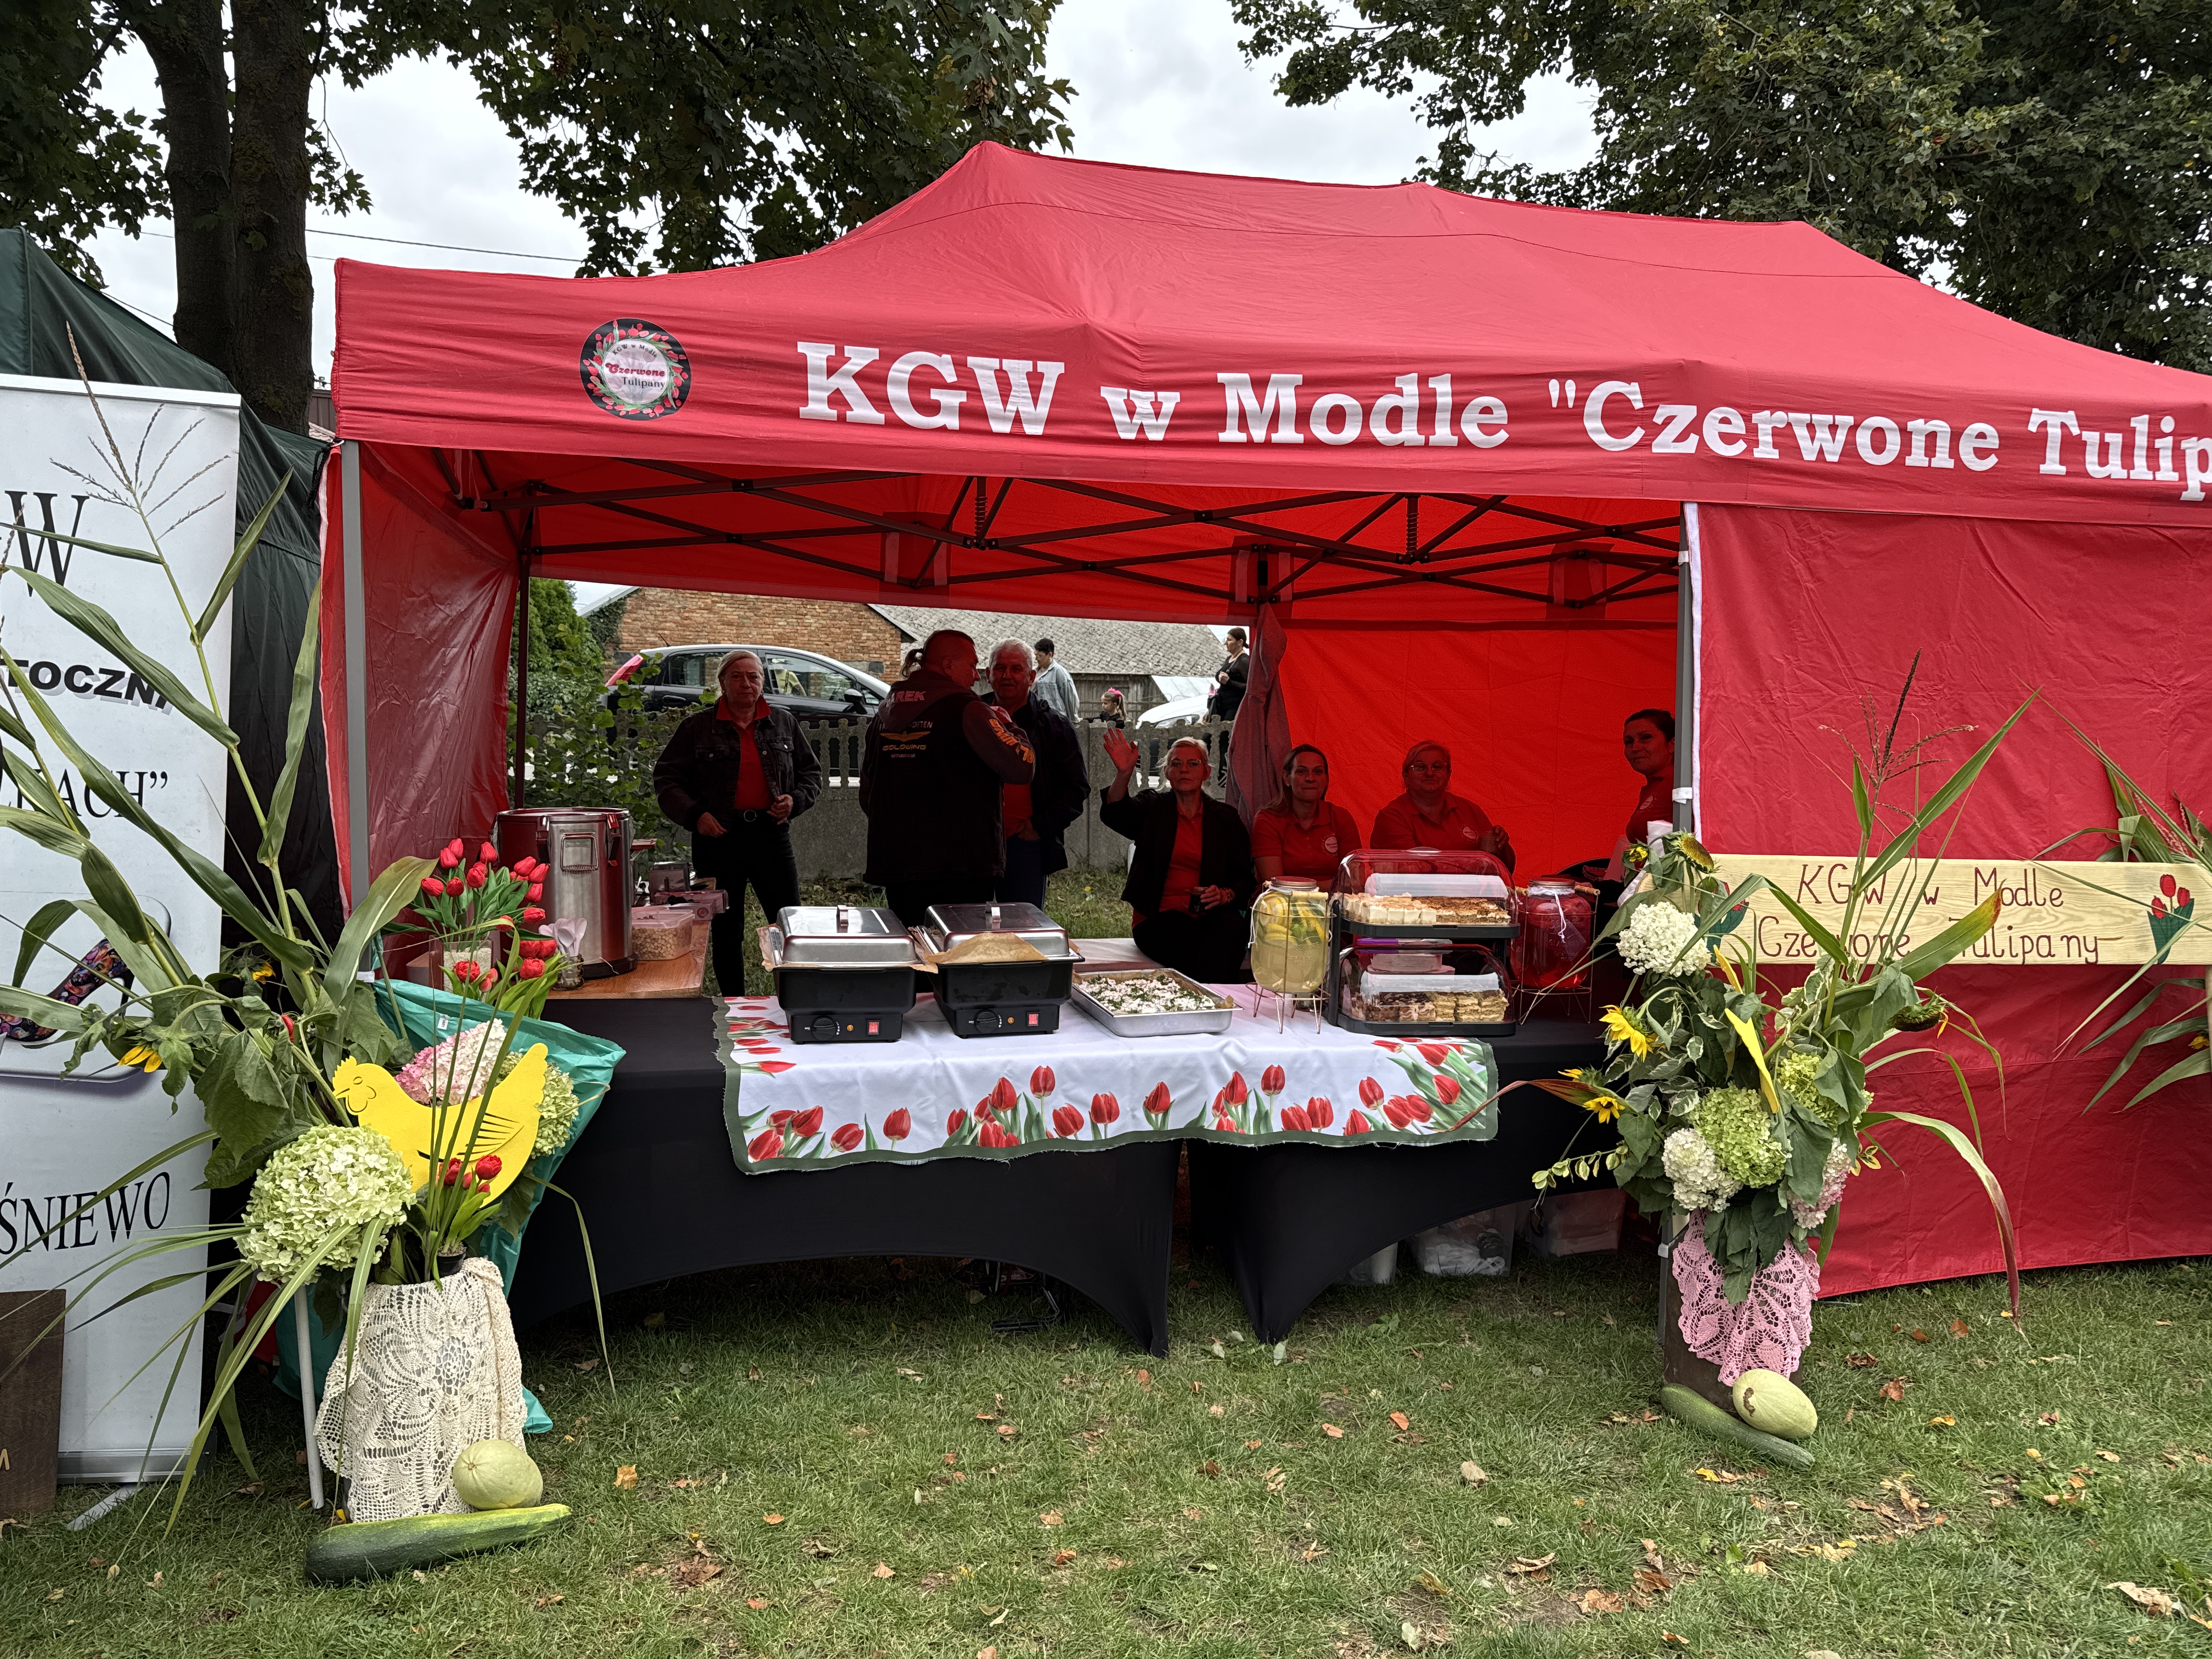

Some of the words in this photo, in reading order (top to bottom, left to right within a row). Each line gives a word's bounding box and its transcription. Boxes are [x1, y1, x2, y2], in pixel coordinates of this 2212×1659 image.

[612, 343, 628, 356] KGW
[639, 344, 657, 358] Modle
[605, 362, 665, 377] Czerwone
[621, 376, 666, 391] Tulipany
[796, 341, 1065, 436] KGW
[1099, 385, 1181, 441] w
[1216, 373, 1510, 449] Modle
[1548, 378, 2000, 471] "Czerwone
[2027, 408, 2212, 501] Tulip
[0, 490, 90, 597] W
[885, 691, 927, 707] REK
[1974, 866, 2064, 907] Modle
[1758, 915, 1911, 958] Czeone
[1948, 916, 2100, 965] ulipany
